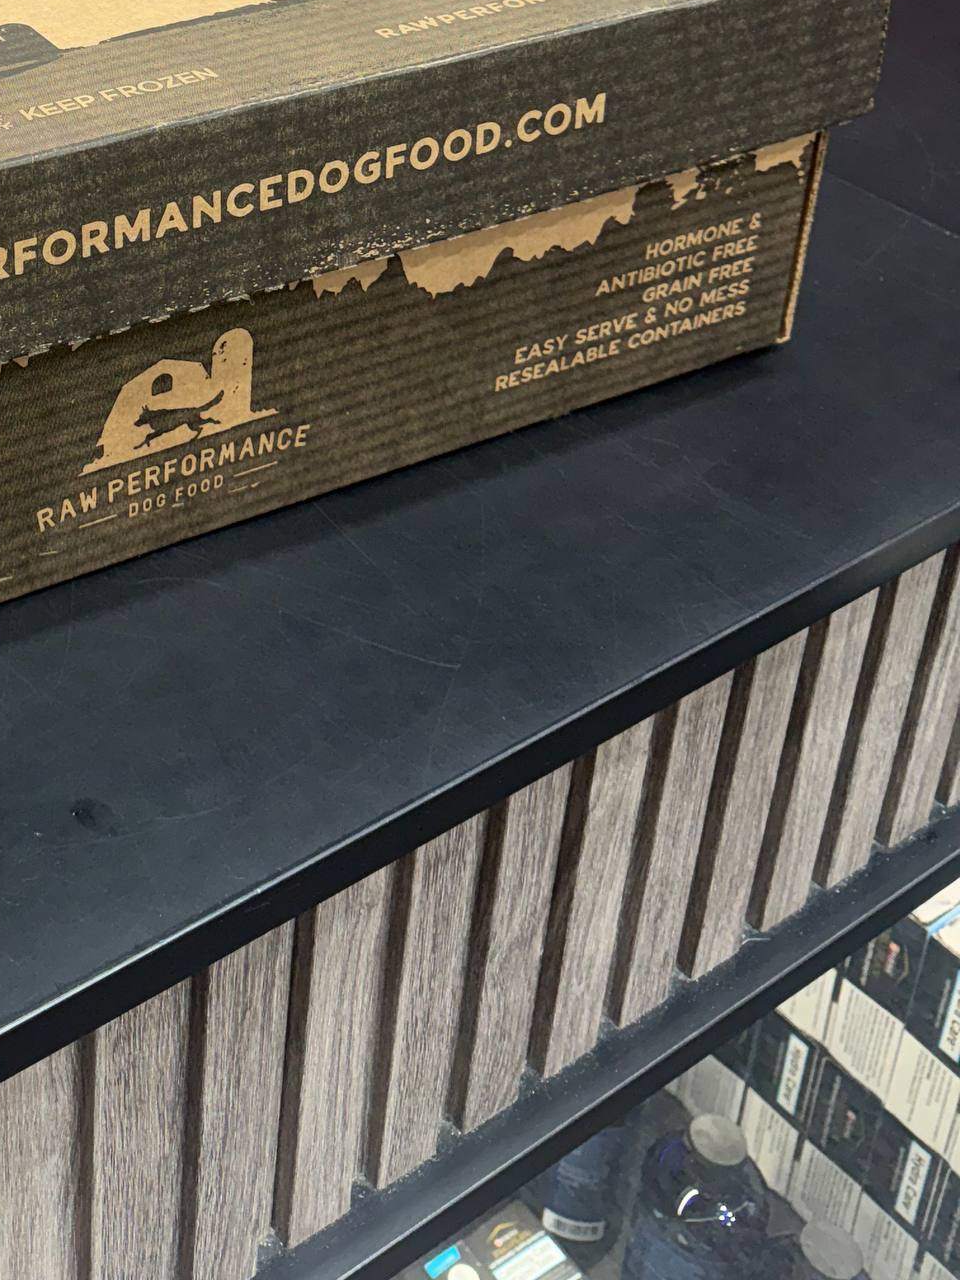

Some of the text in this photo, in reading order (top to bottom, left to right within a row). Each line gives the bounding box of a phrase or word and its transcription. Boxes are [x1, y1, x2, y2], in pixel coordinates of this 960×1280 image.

[17, 67, 220, 120] KEEP FROZEN
[645, 212, 762, 261] HORMONE &
[595, 235, 759, 296] ANTIBIOTIC FREE
[642, 256, 755, 303] GRAIN FREE
[495, 301, 747, 392] RESEALABLE CONTAINERS
[514, 279, 750, 365] EASY SERVE & NO MESS
[36, 424, 311, 532] RAW PERFORMANCE
[128, 474, 224, 518] DOG FOOD
